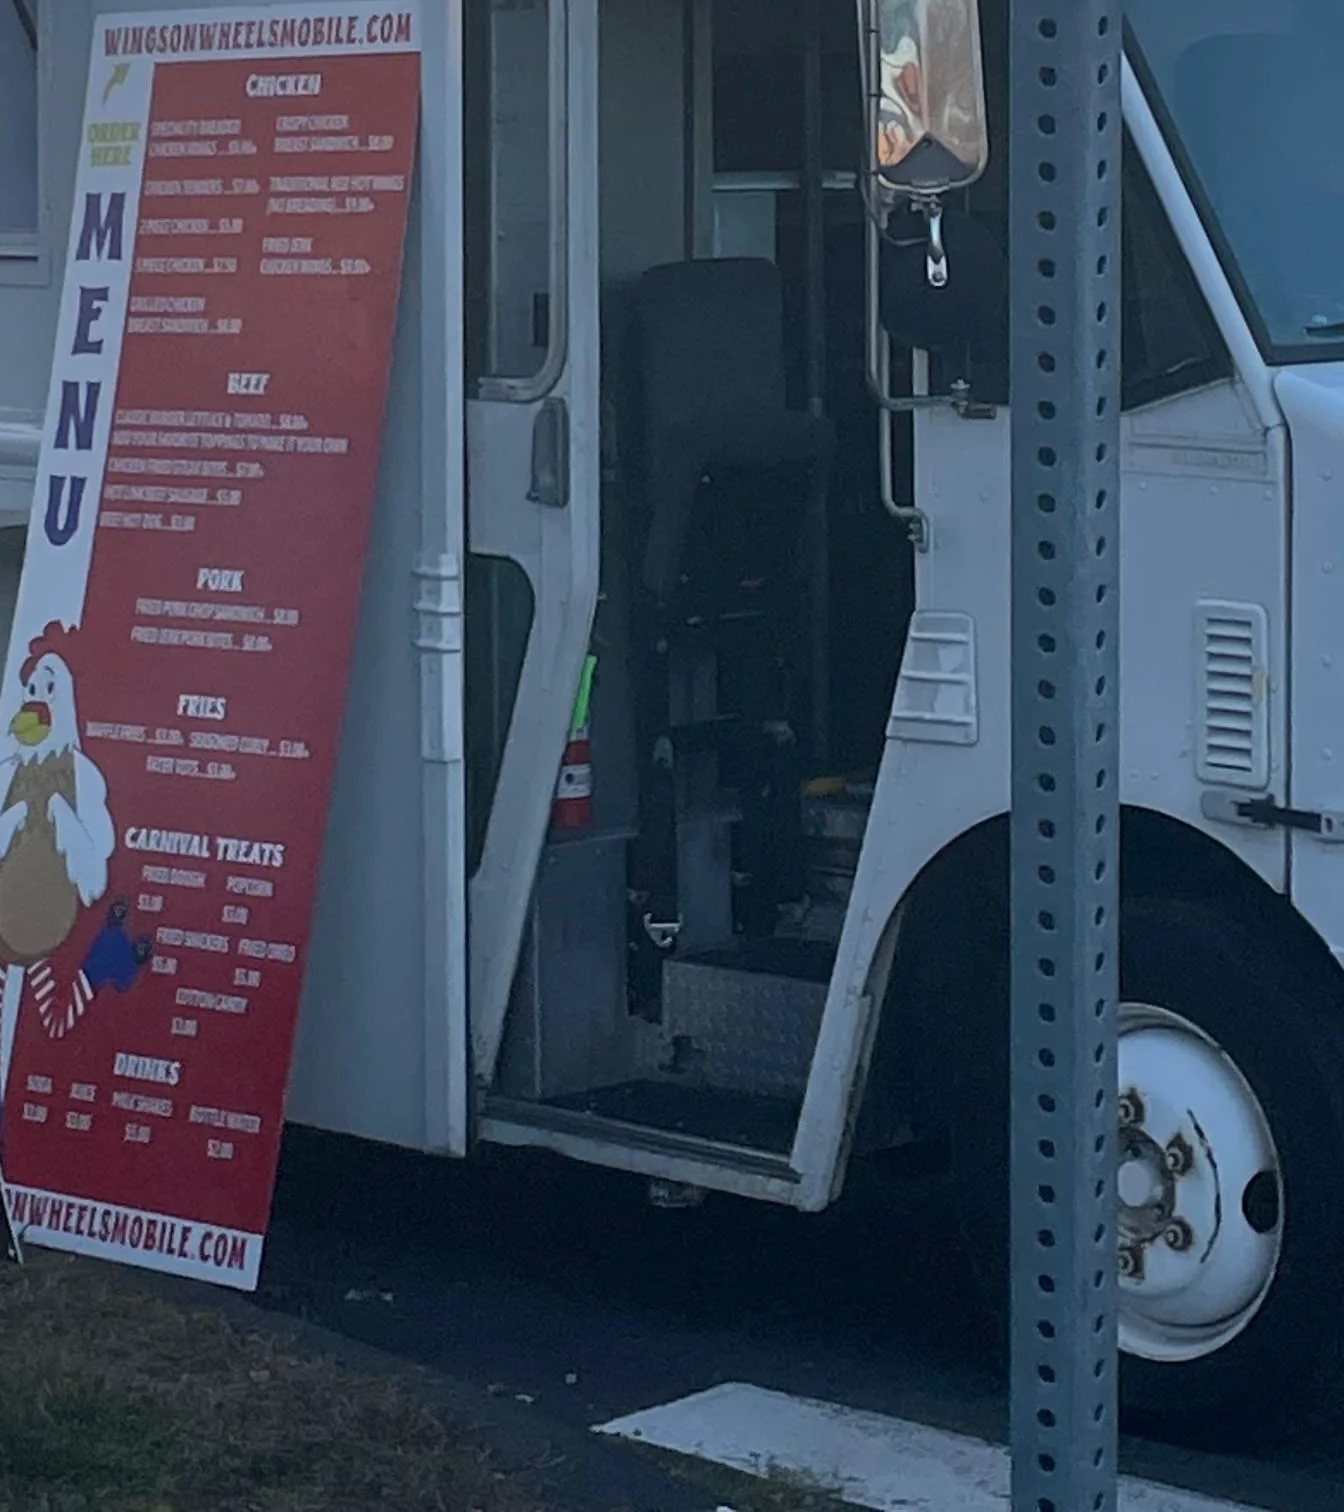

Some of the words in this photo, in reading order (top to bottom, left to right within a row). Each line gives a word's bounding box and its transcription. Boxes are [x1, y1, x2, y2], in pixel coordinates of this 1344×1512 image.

[105, 13, 412, 57] WINGSONWHEELSMOBILE.COM
[246, 73, 321, 97] CHICKEN
[227, 372, 270, 395] BEEF
[196, 568, 245, 592] PORK
[177, 694, 226, 719] FRIES
[125, 827, 210, 858] CARNIVAL
[216, 837, 286, 868] TREATS
[114, 1052, 181, 1085] DRINKS
